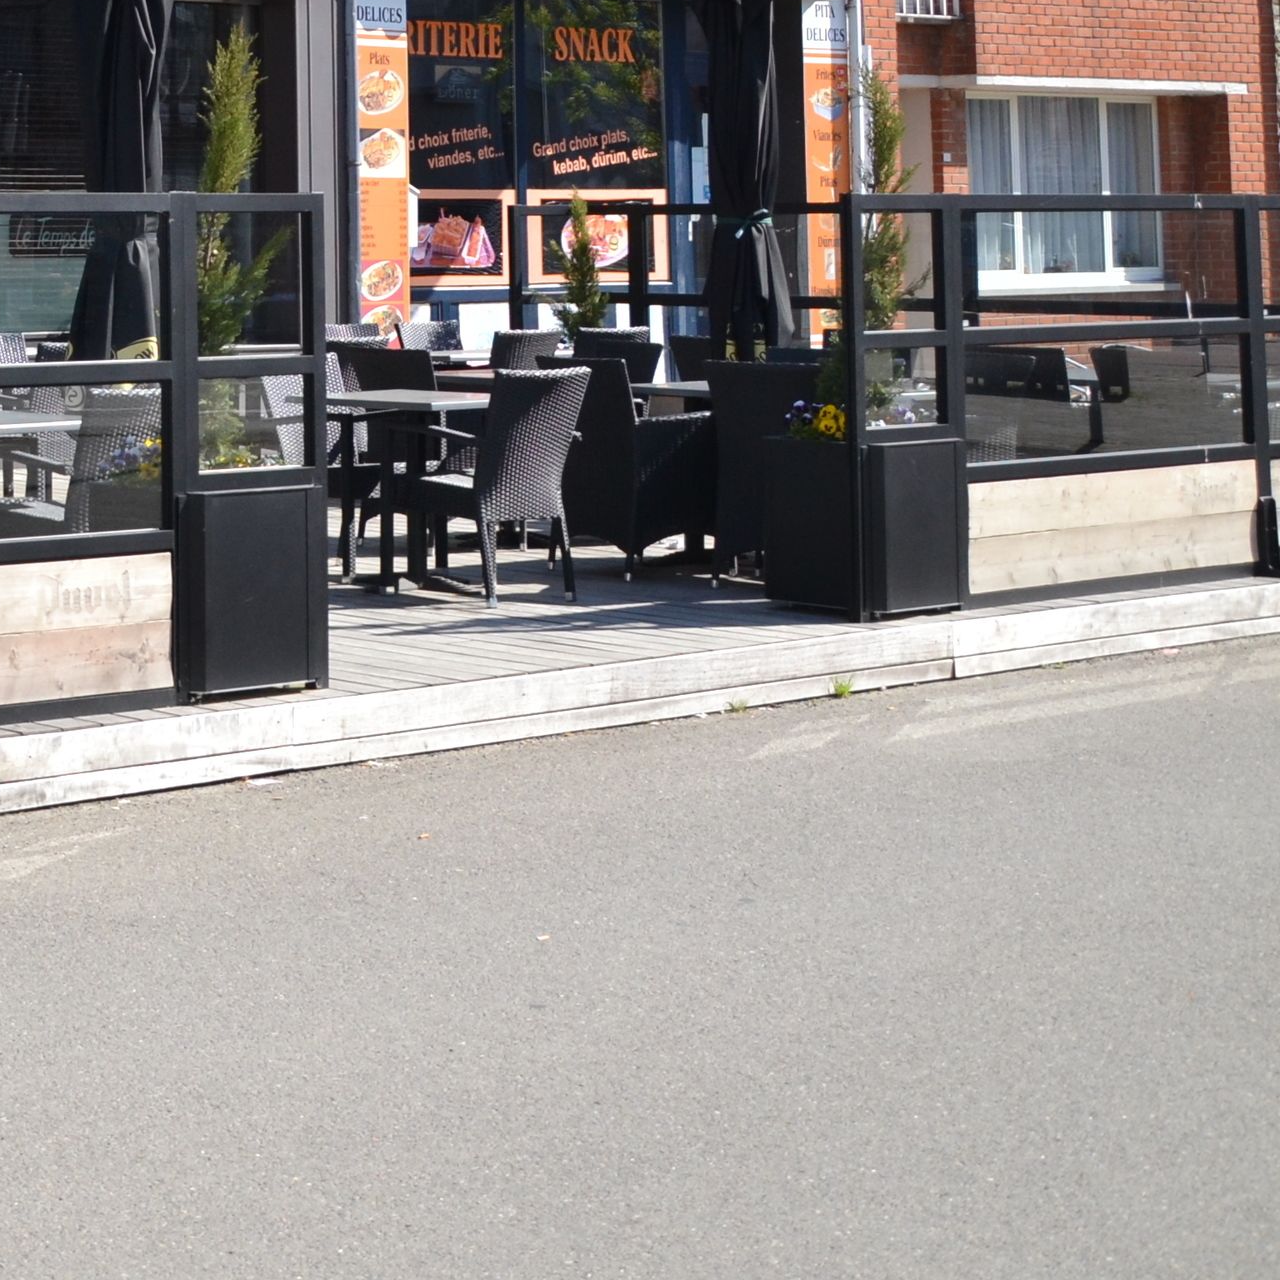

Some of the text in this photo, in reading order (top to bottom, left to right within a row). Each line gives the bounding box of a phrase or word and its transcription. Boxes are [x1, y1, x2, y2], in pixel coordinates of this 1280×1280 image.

[356, 5, 402, 23] DELICES
[815, 4, 835, 18] PITA
[554, 26, 636, 62] SNACK
[806, 27, 845, 42] DELICES
[369, 52, 390, 65] Plats
[418, 131, 449, 149] choix
[452, 124, 492, 143] friterie,
[533, 129, 630, 157] Grand choix plats,
[427, 145, 505, 169] viandes, etc...
[553, 155, 590, 175] kebab,
